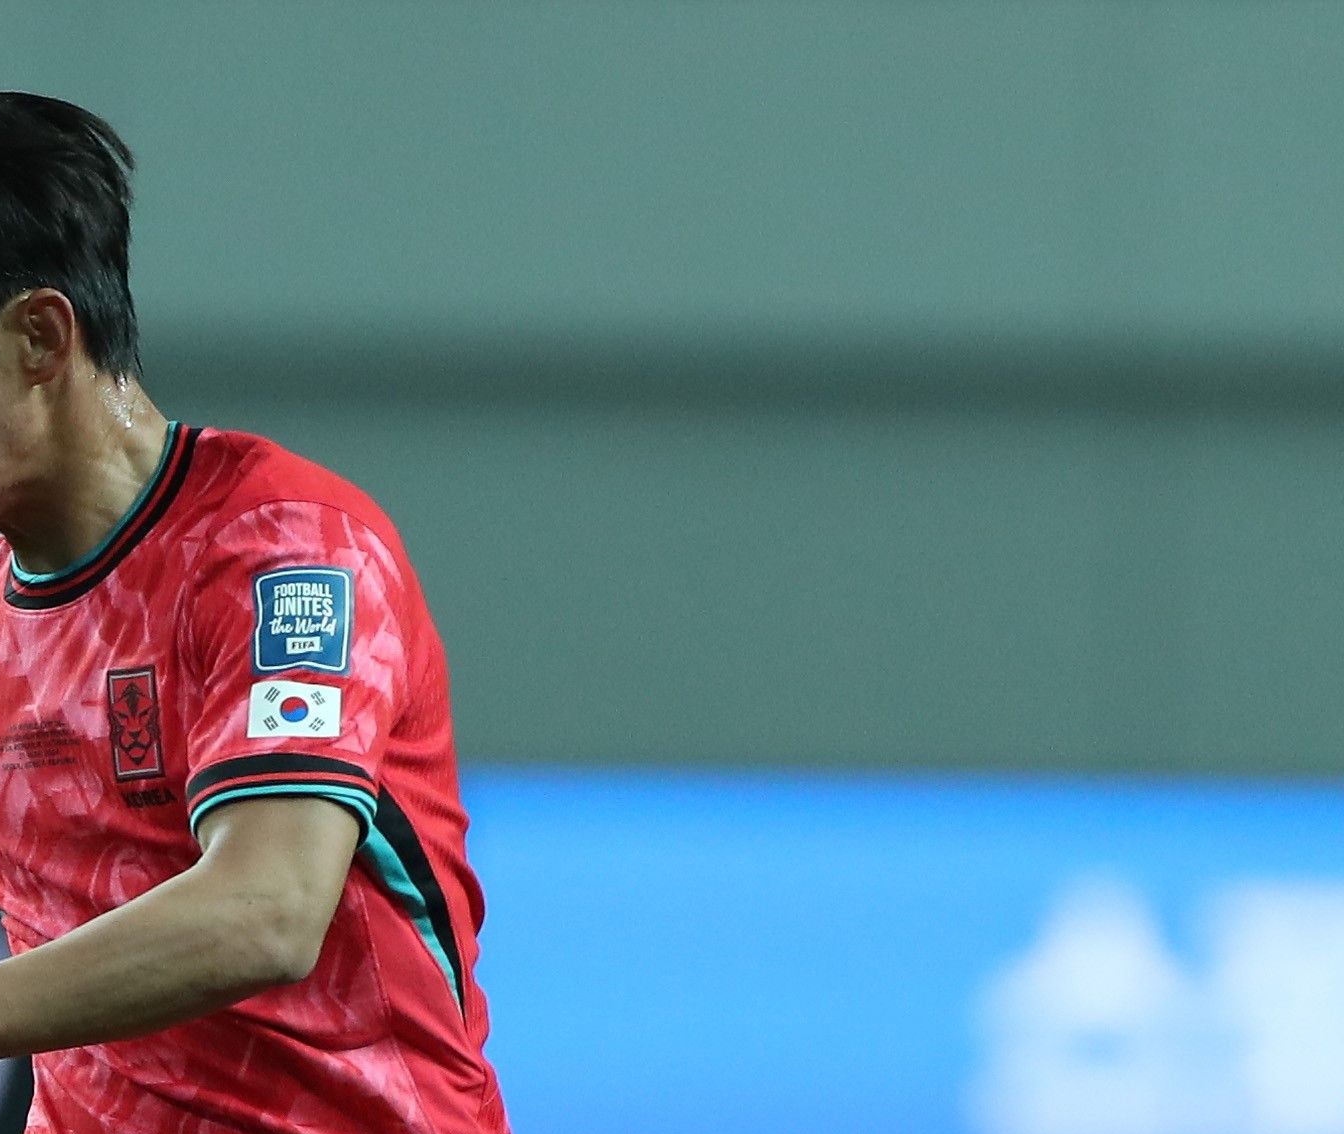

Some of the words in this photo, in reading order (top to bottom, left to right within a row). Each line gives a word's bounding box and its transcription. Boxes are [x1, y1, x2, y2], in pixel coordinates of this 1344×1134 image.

[274, 583, 332, 598] FOOTBALL
[274, 597, 333, 616] UNITES
[269, 617, 293, 635] the
[296, 617, 337, 636] World
[291, 641, 315, 650] FIFA
